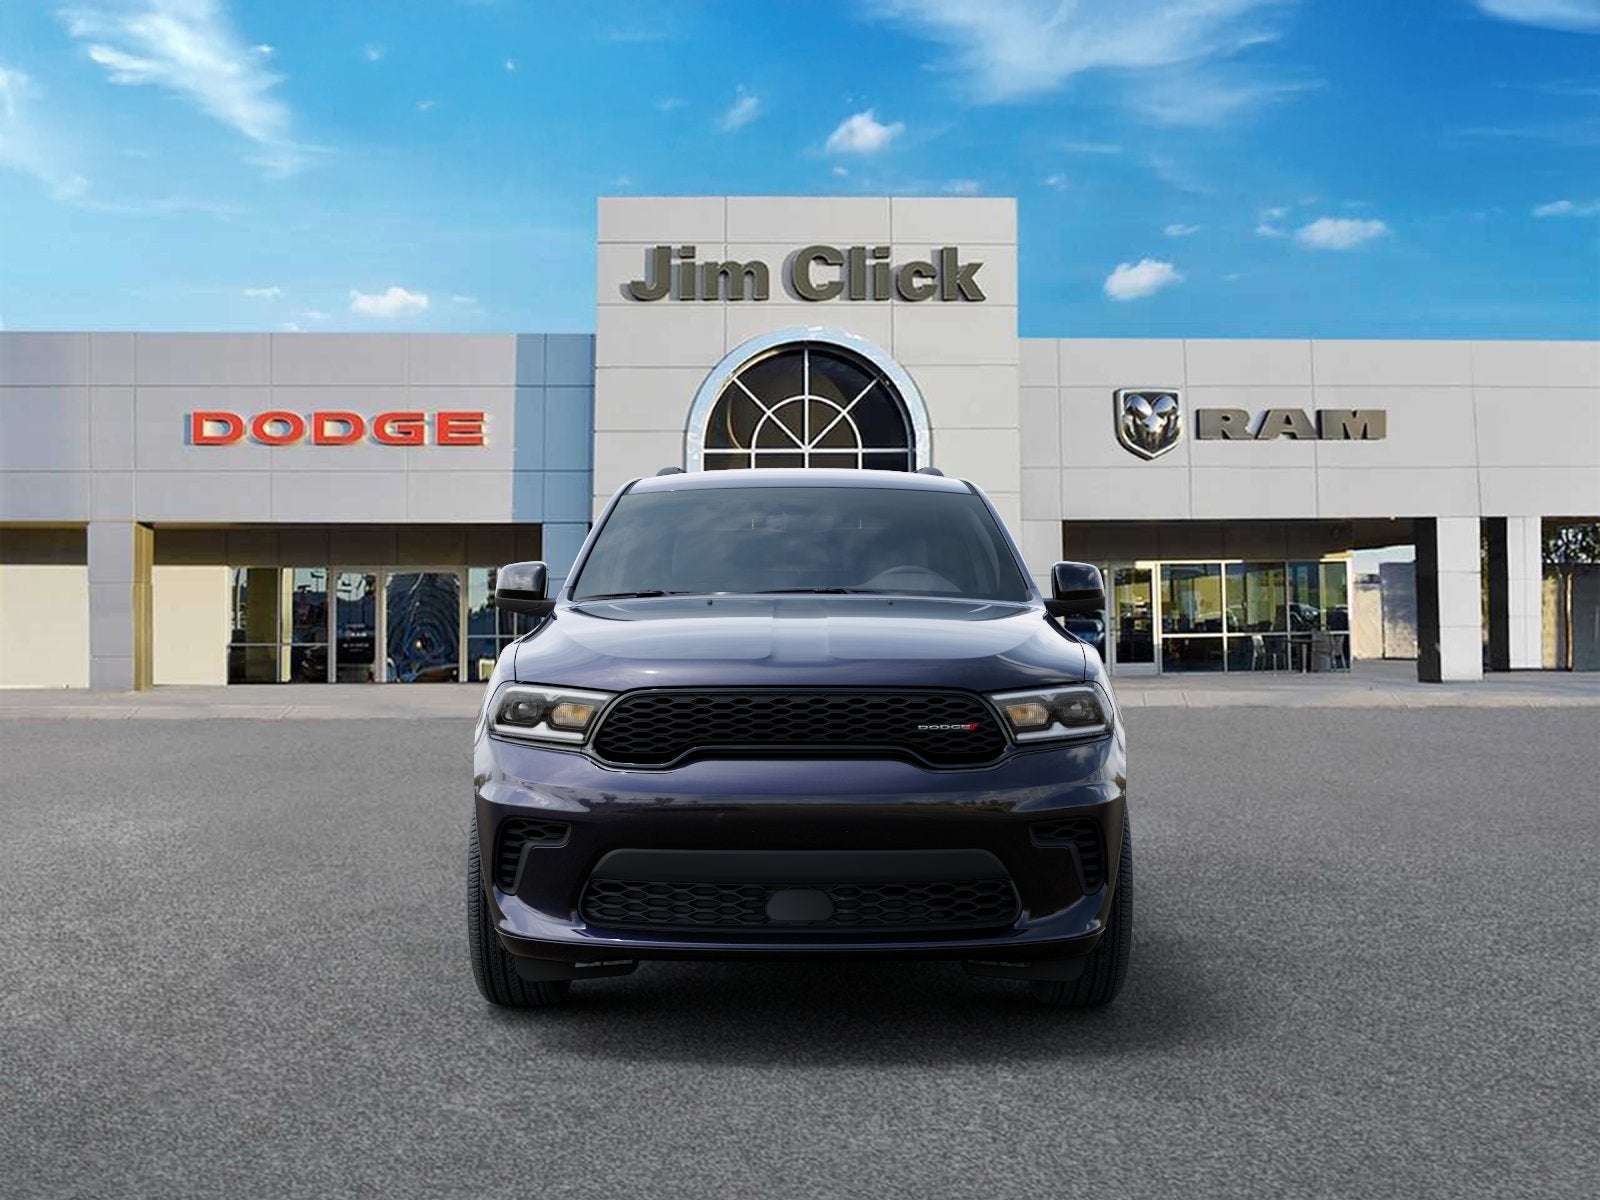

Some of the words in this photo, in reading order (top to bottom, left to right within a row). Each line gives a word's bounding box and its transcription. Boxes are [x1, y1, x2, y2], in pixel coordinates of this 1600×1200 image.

[627, 244, 771, 302] Jim
[790, 244, 987, 302] Click
[190, 410, 485, 446] DODGE
[1196, 408, 1387, 440] RAM
[917, 723, 972, 731] DODGE
